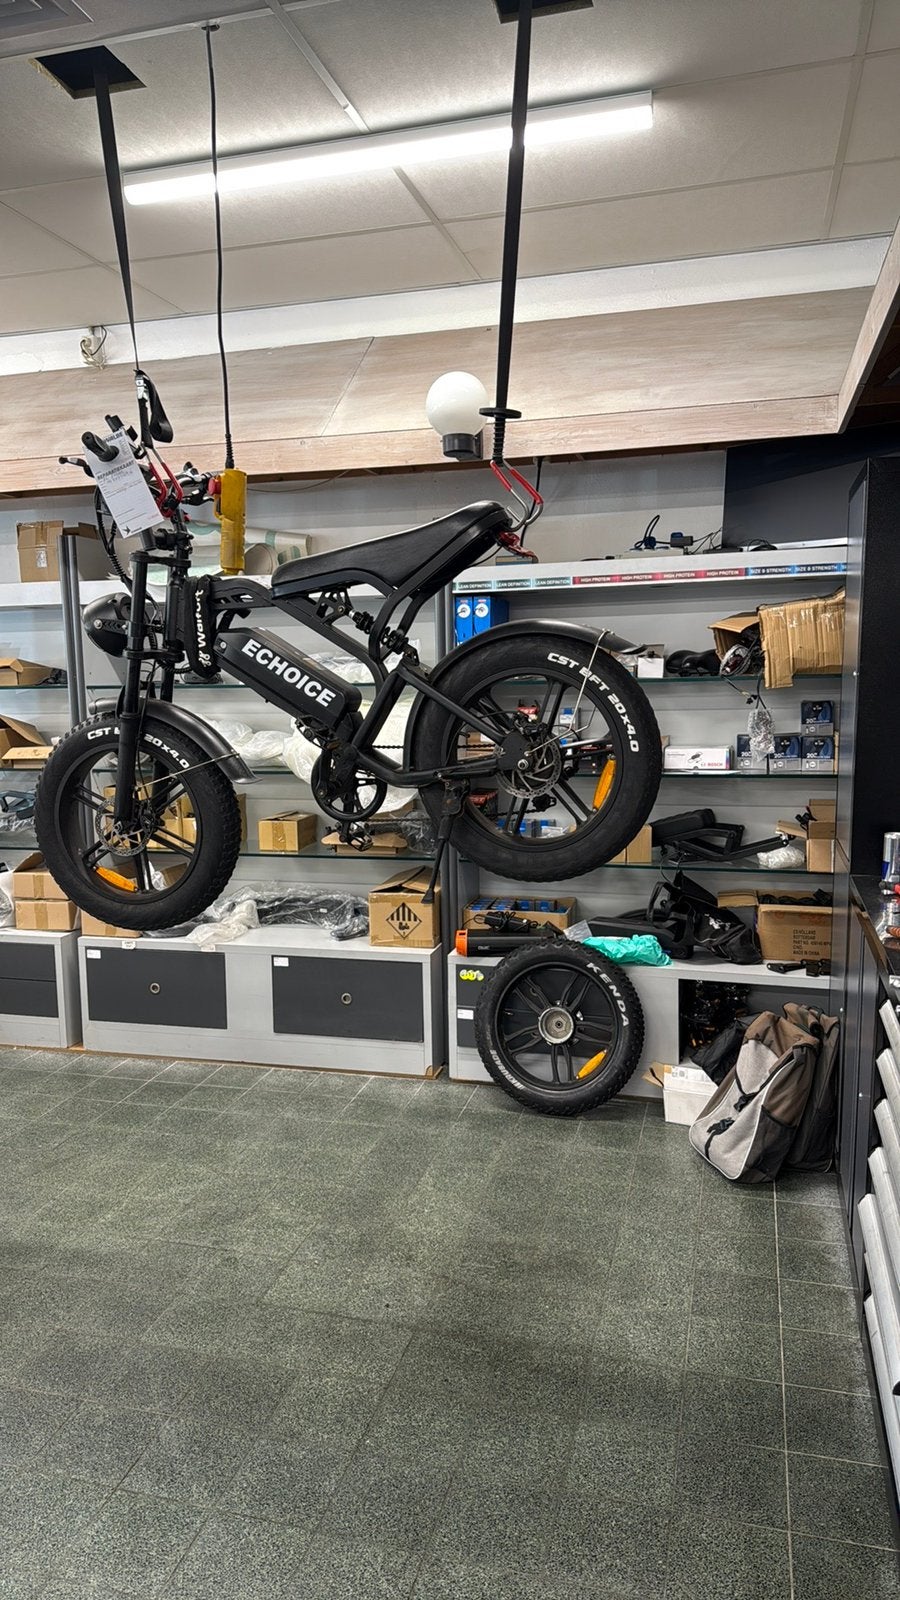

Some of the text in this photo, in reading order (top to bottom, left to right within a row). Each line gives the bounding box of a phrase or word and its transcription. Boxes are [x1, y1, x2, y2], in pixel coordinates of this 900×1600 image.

[241, 638, 337, 707] ECHOICE
[547, 652, 580, 668] CST
[579, 667, 610, 692] BFT
[87, 726, 112, 741] CST
[587, 962, 629, 1027] KENDA
